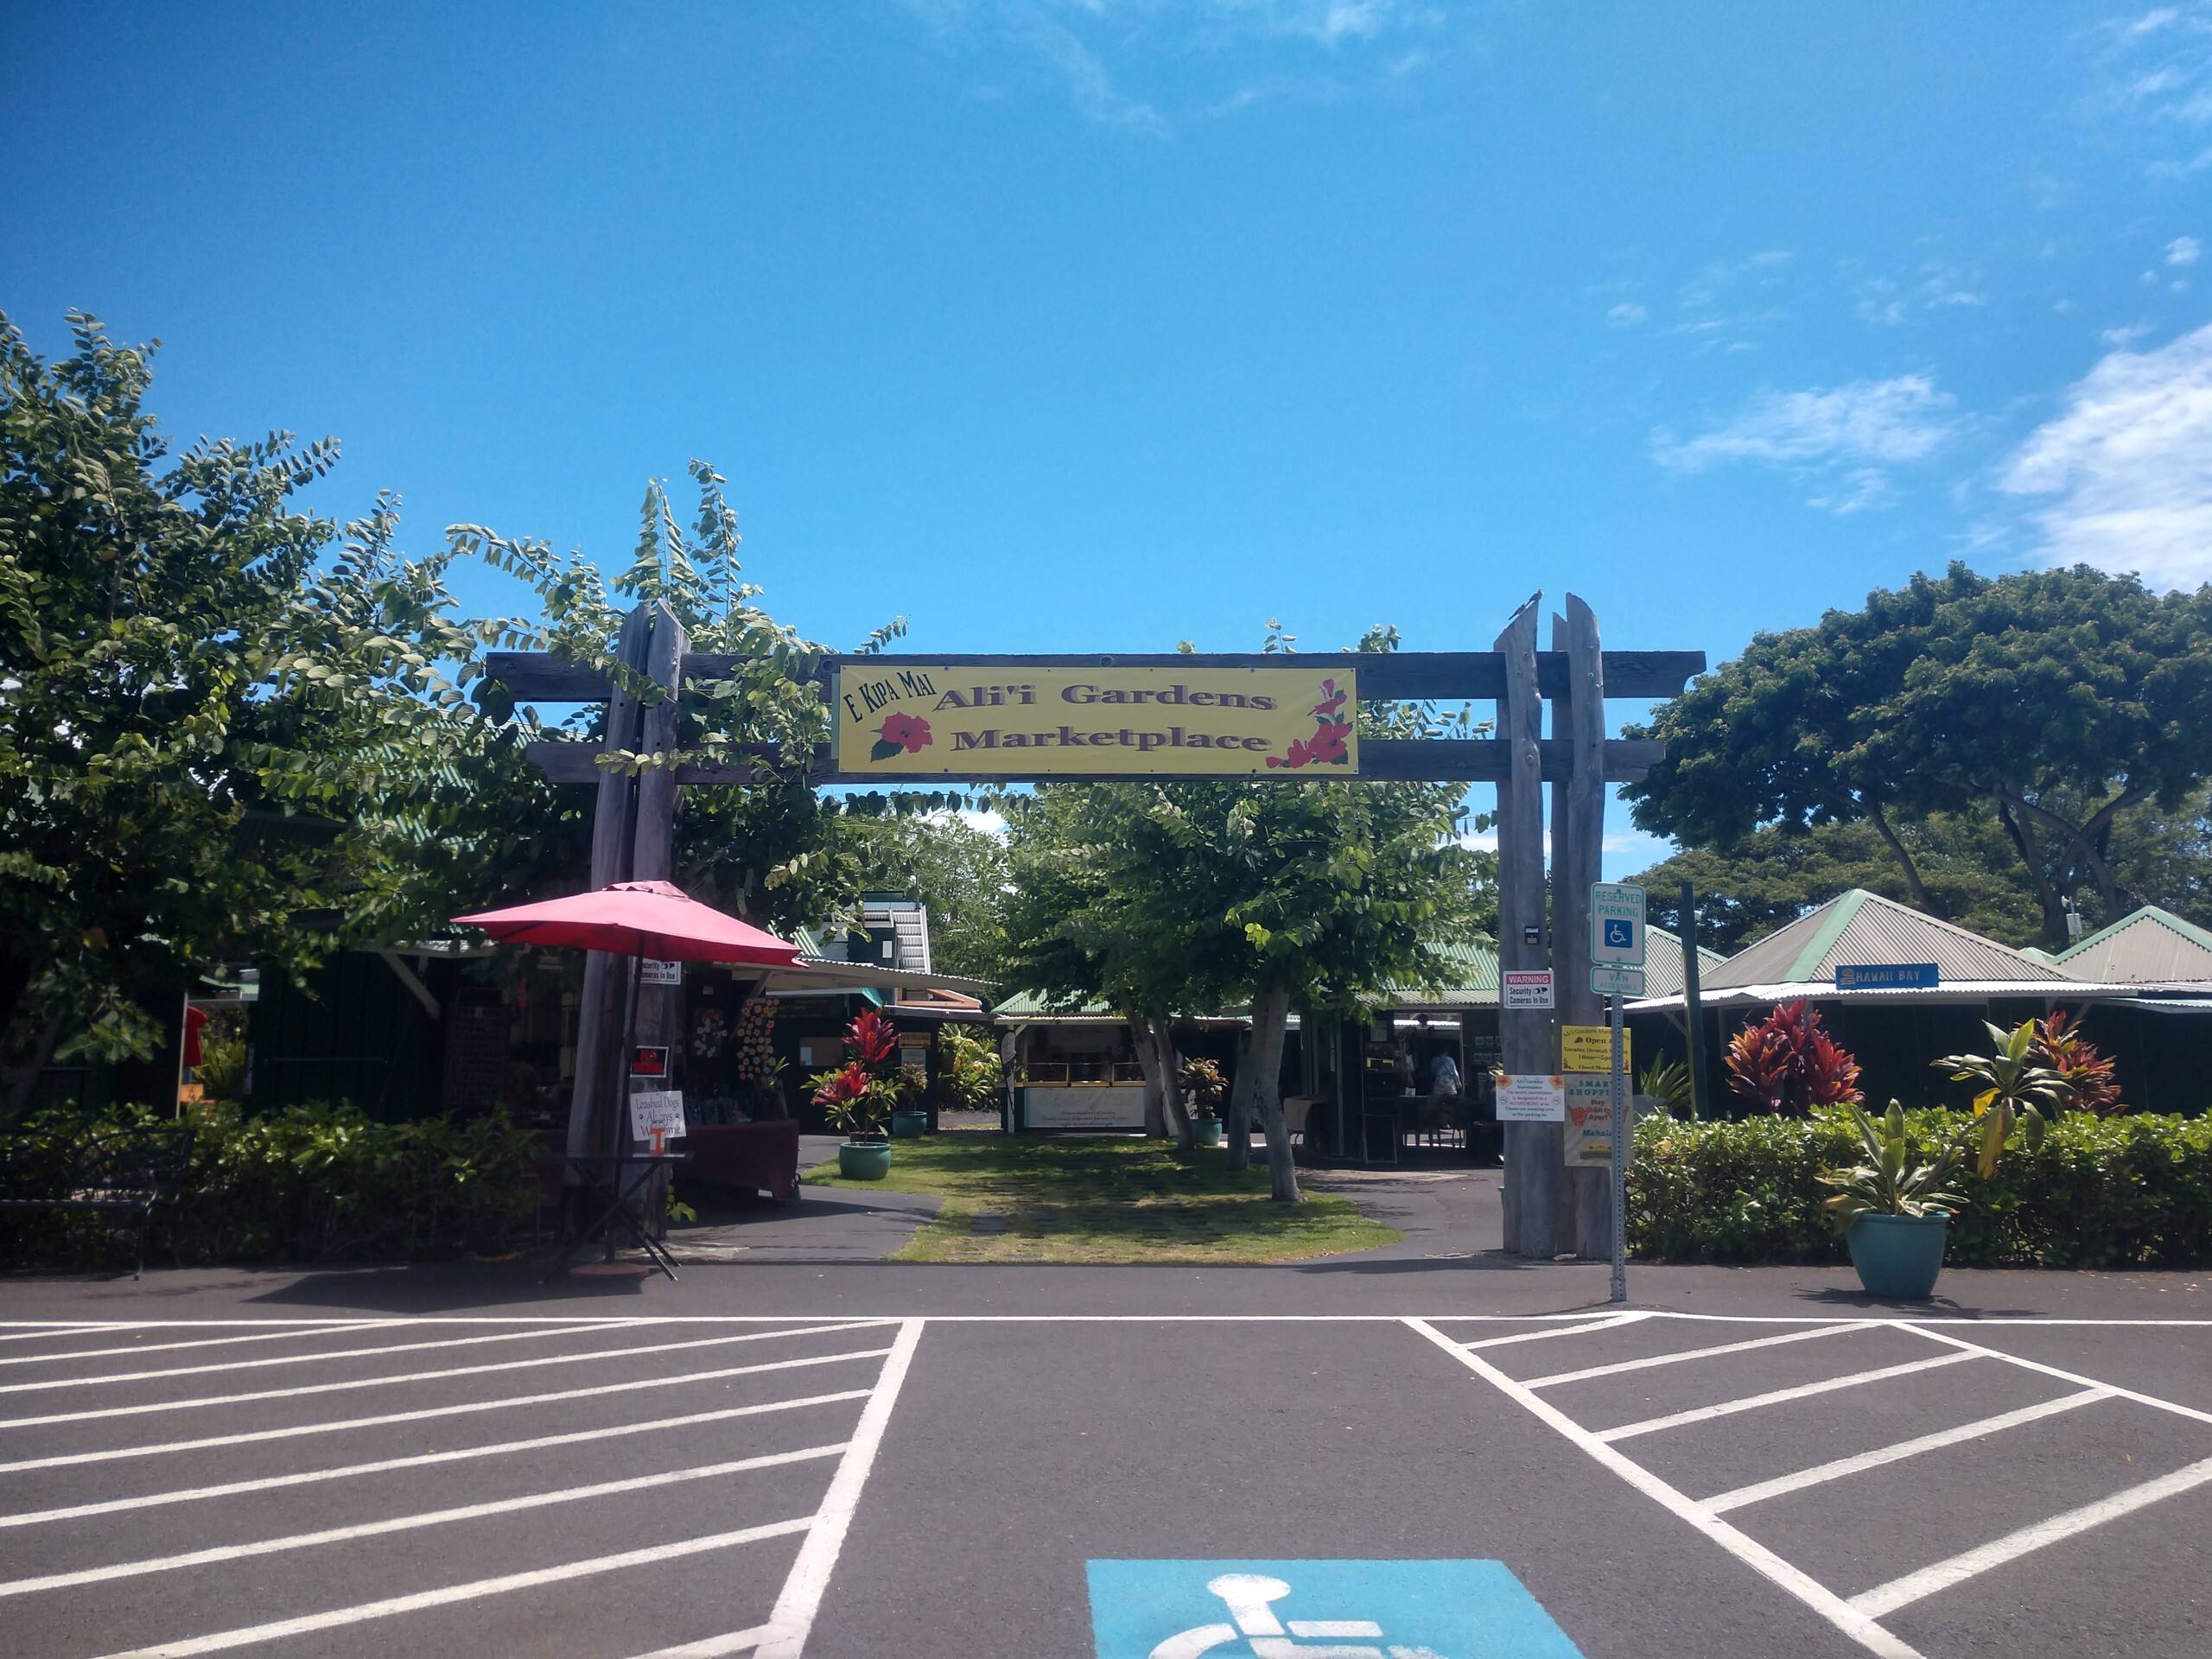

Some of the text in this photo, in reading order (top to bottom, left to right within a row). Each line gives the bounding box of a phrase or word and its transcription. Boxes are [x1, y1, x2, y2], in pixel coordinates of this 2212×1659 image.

[931, 684, 1277, 712] Ali'i Gardens
[843, 694, 862, 722] E
[950, 726, 1272, 752] Marketplace
[1595, 891, 1642, 904] RESERVED
[1599, 905, 1639, 917] PARKING
[642, 961, 659, 971] ecurity
[1609, 973, 1629, 982] VAN
[1856, 970, 1921, 982] HAWAII BAY
[1510, 987, 1532, 996] Security
[636, 1095, 680, 1110] Leashed Dogs
[646, 1109, 673, 1126] Alays
